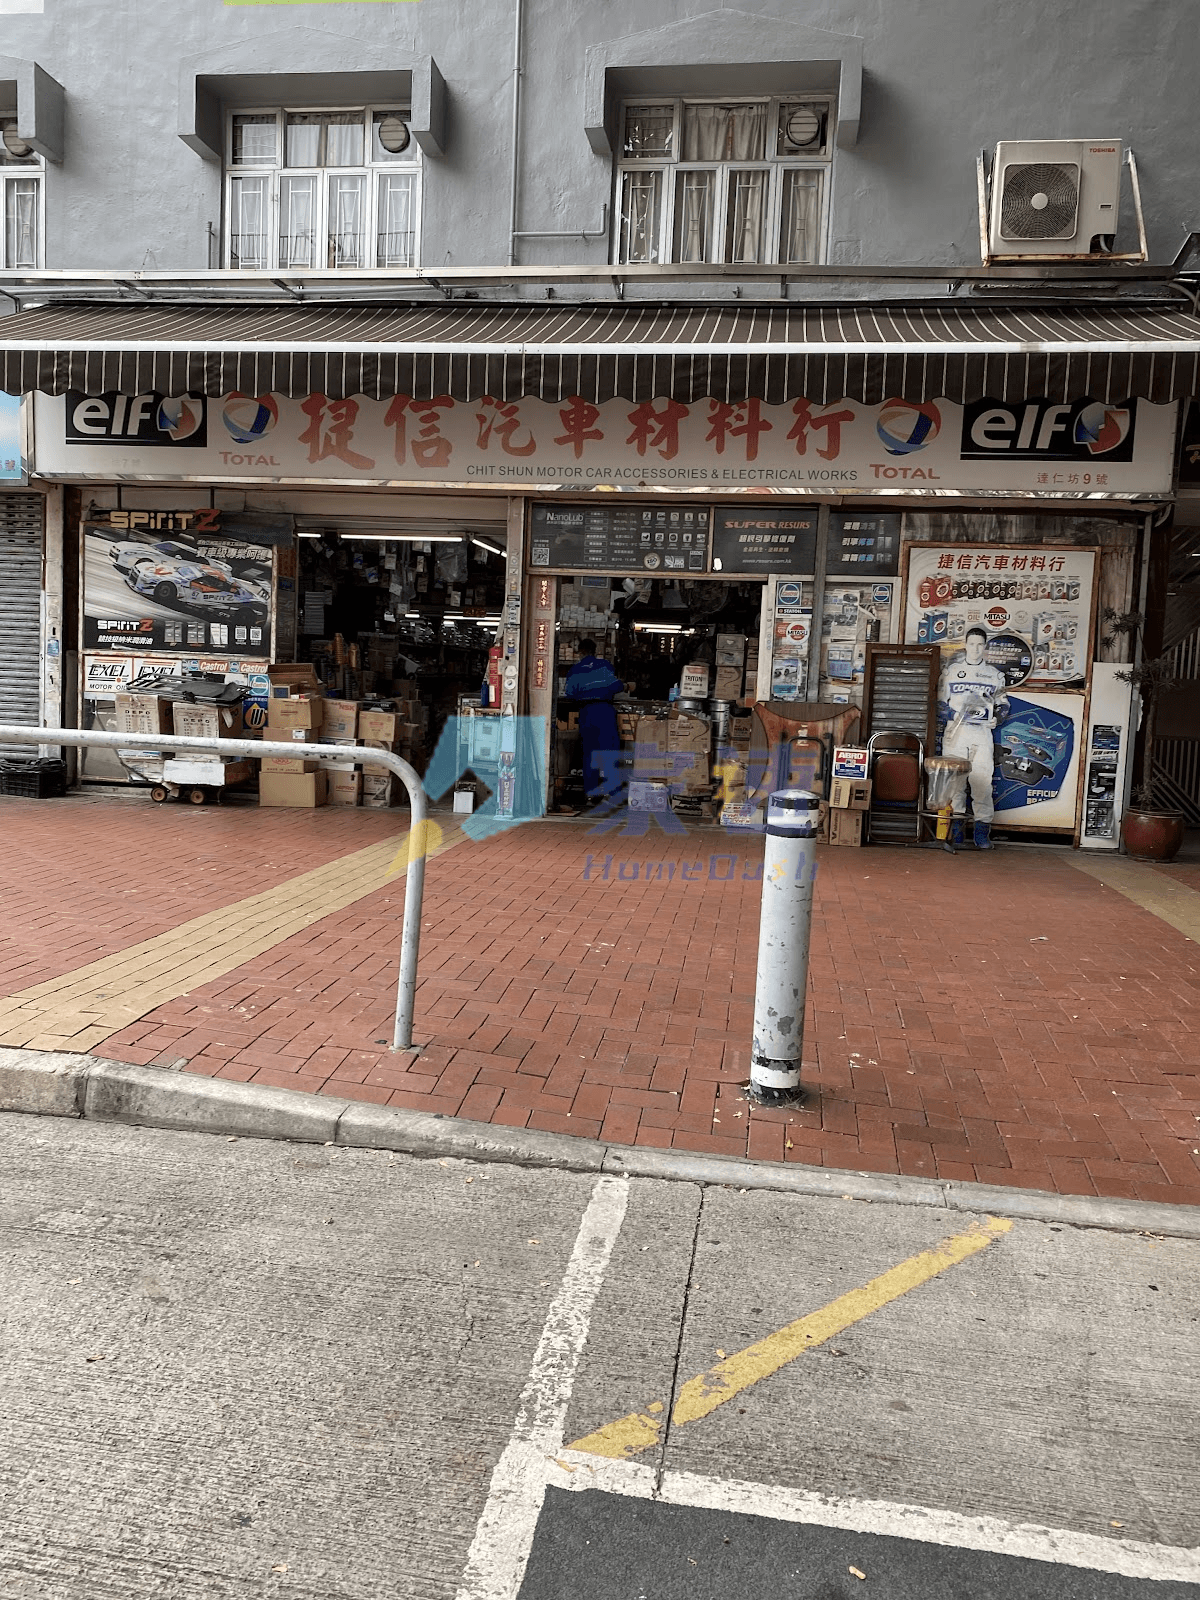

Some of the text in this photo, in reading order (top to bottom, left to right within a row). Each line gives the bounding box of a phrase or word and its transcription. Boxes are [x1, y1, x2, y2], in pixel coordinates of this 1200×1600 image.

[72, 395, 154, 436] elf
[970, 404, 1073, 450] elf
[218, 451, 281, 466] TOTAL
[466, 465, 858, 482] CHIT SHUN MOTOR CAR ACCESSORIES & ELECTRICAL WORKS
[869, 463, 941, 481] TOTAL
[546, 512, 584, 521] NanoLub
[724, 521, 811, 530] SUPER RESURS
[937, 553, 1066, 572] 捷信汽車材料行
[983, 613, 1011, 621] MITASU
[200, 661, 228, 672] Castrol
[240, 663, 268, 673] Castrol
[838, 752, 864, 760] ABRO
